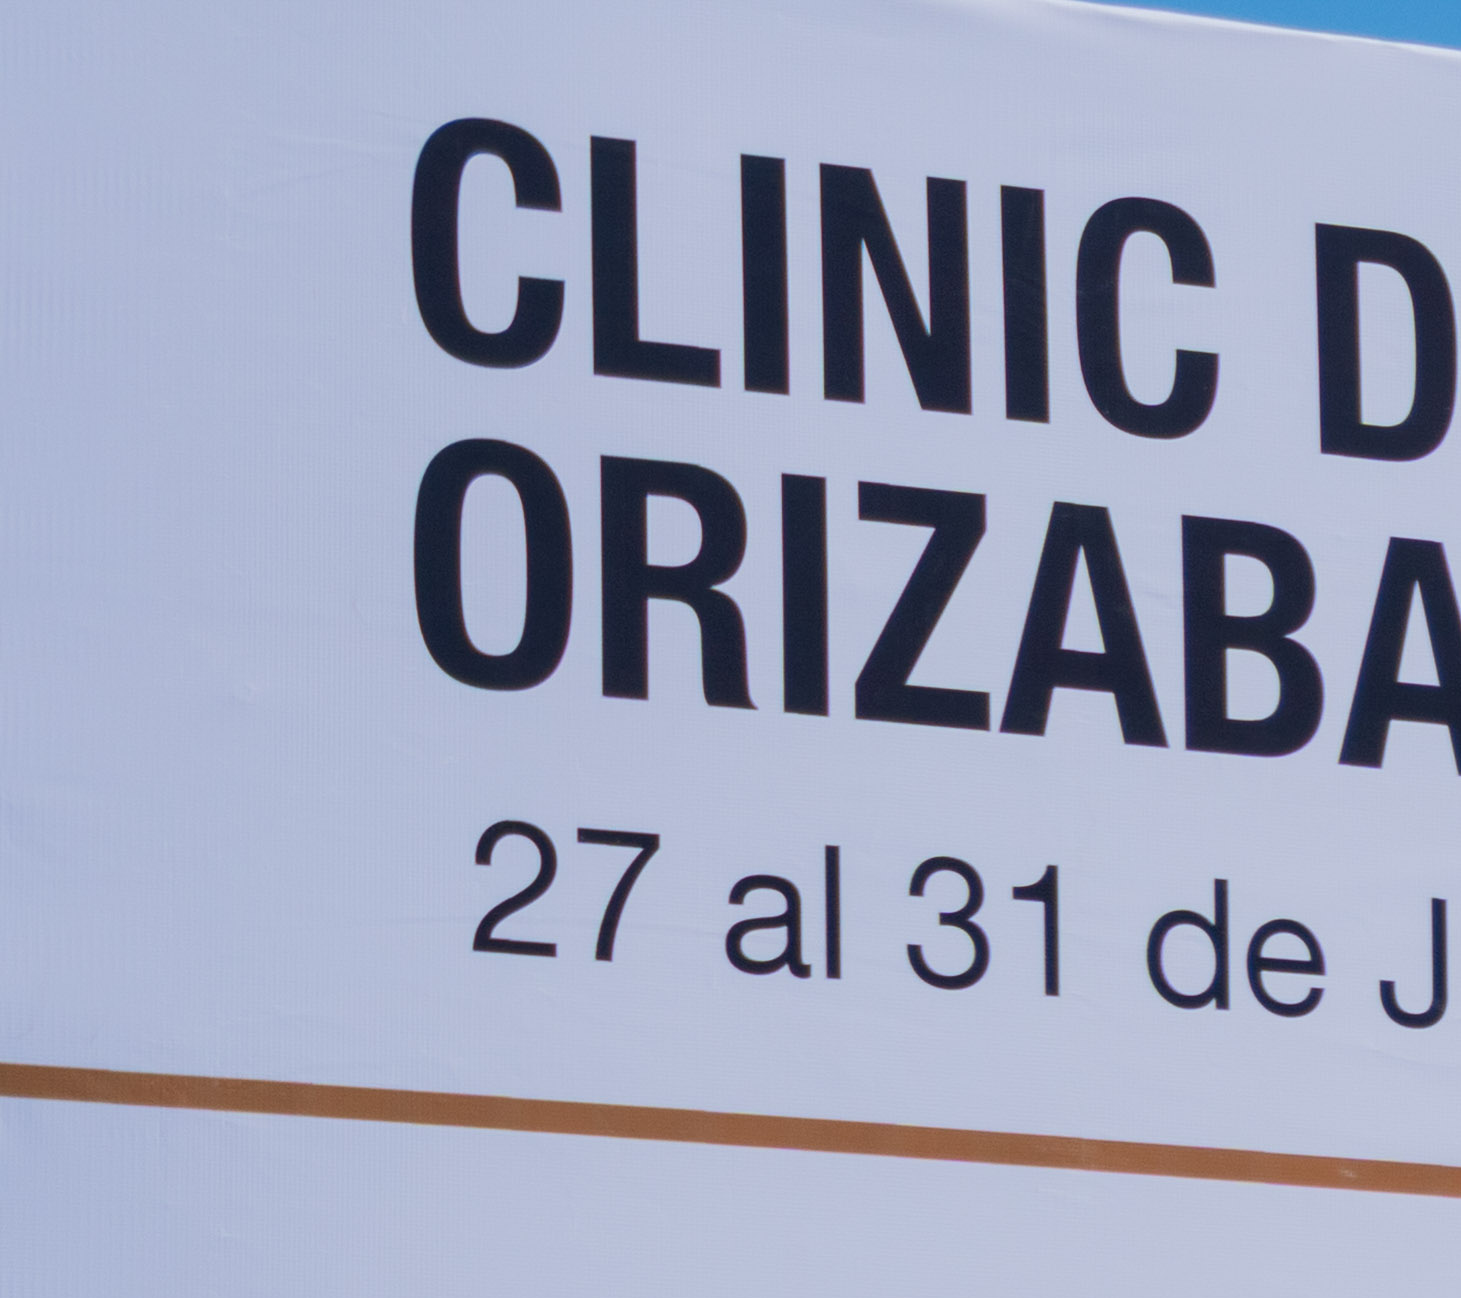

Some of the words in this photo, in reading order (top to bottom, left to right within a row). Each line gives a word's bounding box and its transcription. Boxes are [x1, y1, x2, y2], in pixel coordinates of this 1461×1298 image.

[411, 118, 1218, 439] CLINIC
[473, 820, 659, 961] 27
[726, 845, 840, 979] al
[907, 856, 1059, 996] 31
[1147, 879, 1325, 1017] de
